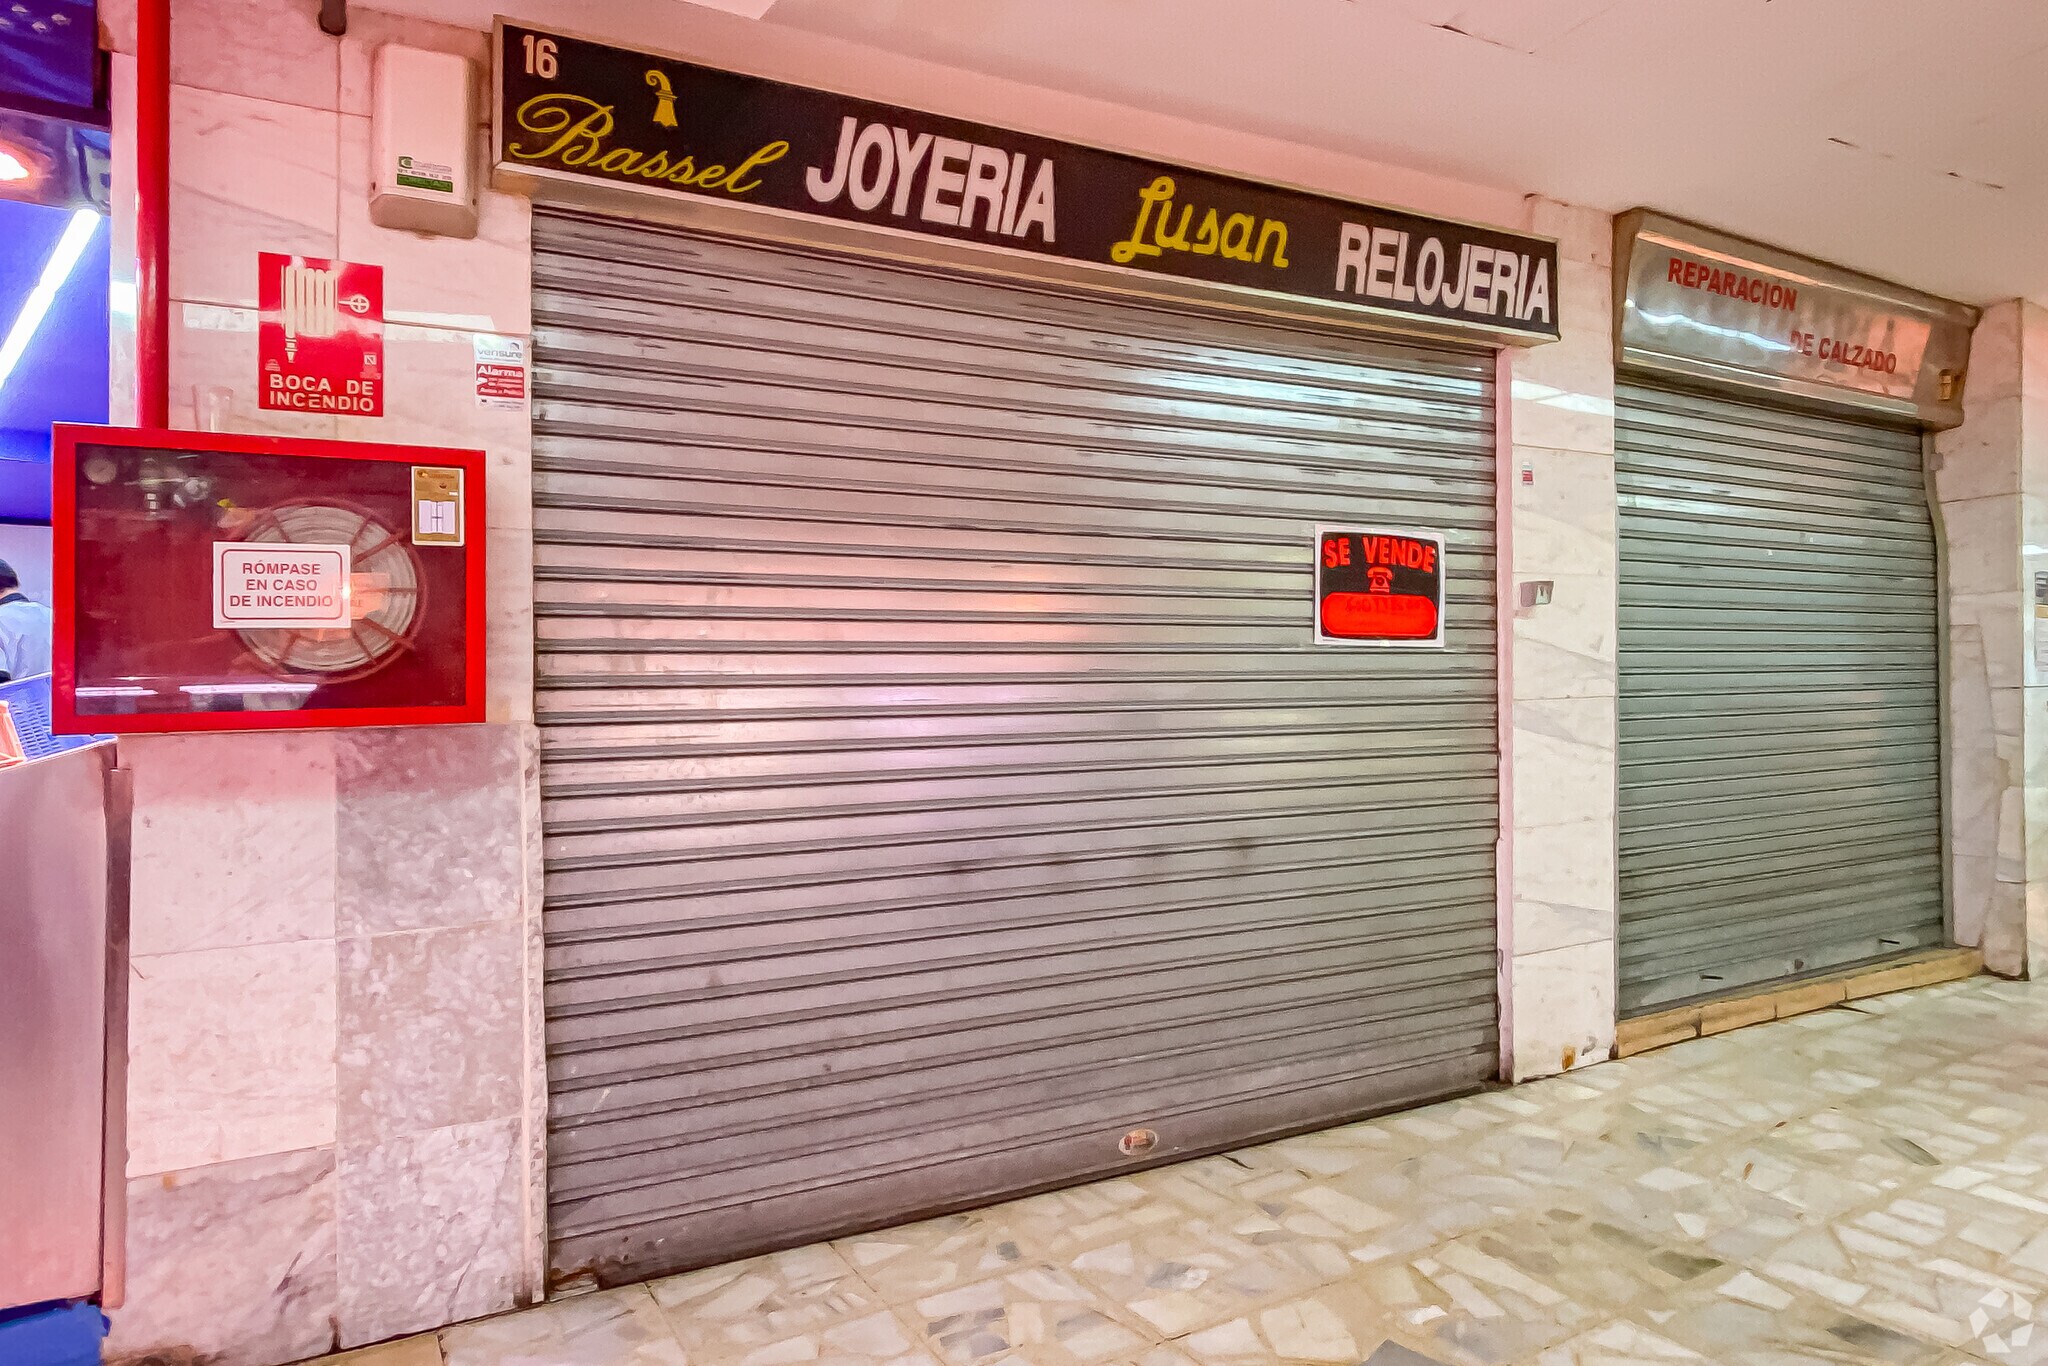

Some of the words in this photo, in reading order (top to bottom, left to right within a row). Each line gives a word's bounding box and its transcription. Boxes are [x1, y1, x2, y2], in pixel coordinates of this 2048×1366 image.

[523, 35, 558, 79] 16
[509, 93, 790, 193] Bassel
[805, 115, 1056, 242] JOYERIA
[1110, 176, 1290, 268] Lusan
[1335, 221, 1551, 324] RELOJERIA
[1667, 257, 1798, 312] REPARACION
[1818, 337, 1897, 374] CALZADO
[269, 373, 332, 392] BOCA
[346, 379, 374, 396] DE
[269, 390, 375, 412] INCENDIO
[242, 560, 321, 575] RÓMPASE
[1324, 537, 1351, 569] SE
[1362, 536, 1437, 574] VENDE
[229, 595, 252, 607] DE
[256, 595, 333, 607] INCENDIO
[246, 579, 268, 591] EN
[272, 579, 318, 592] CASO
